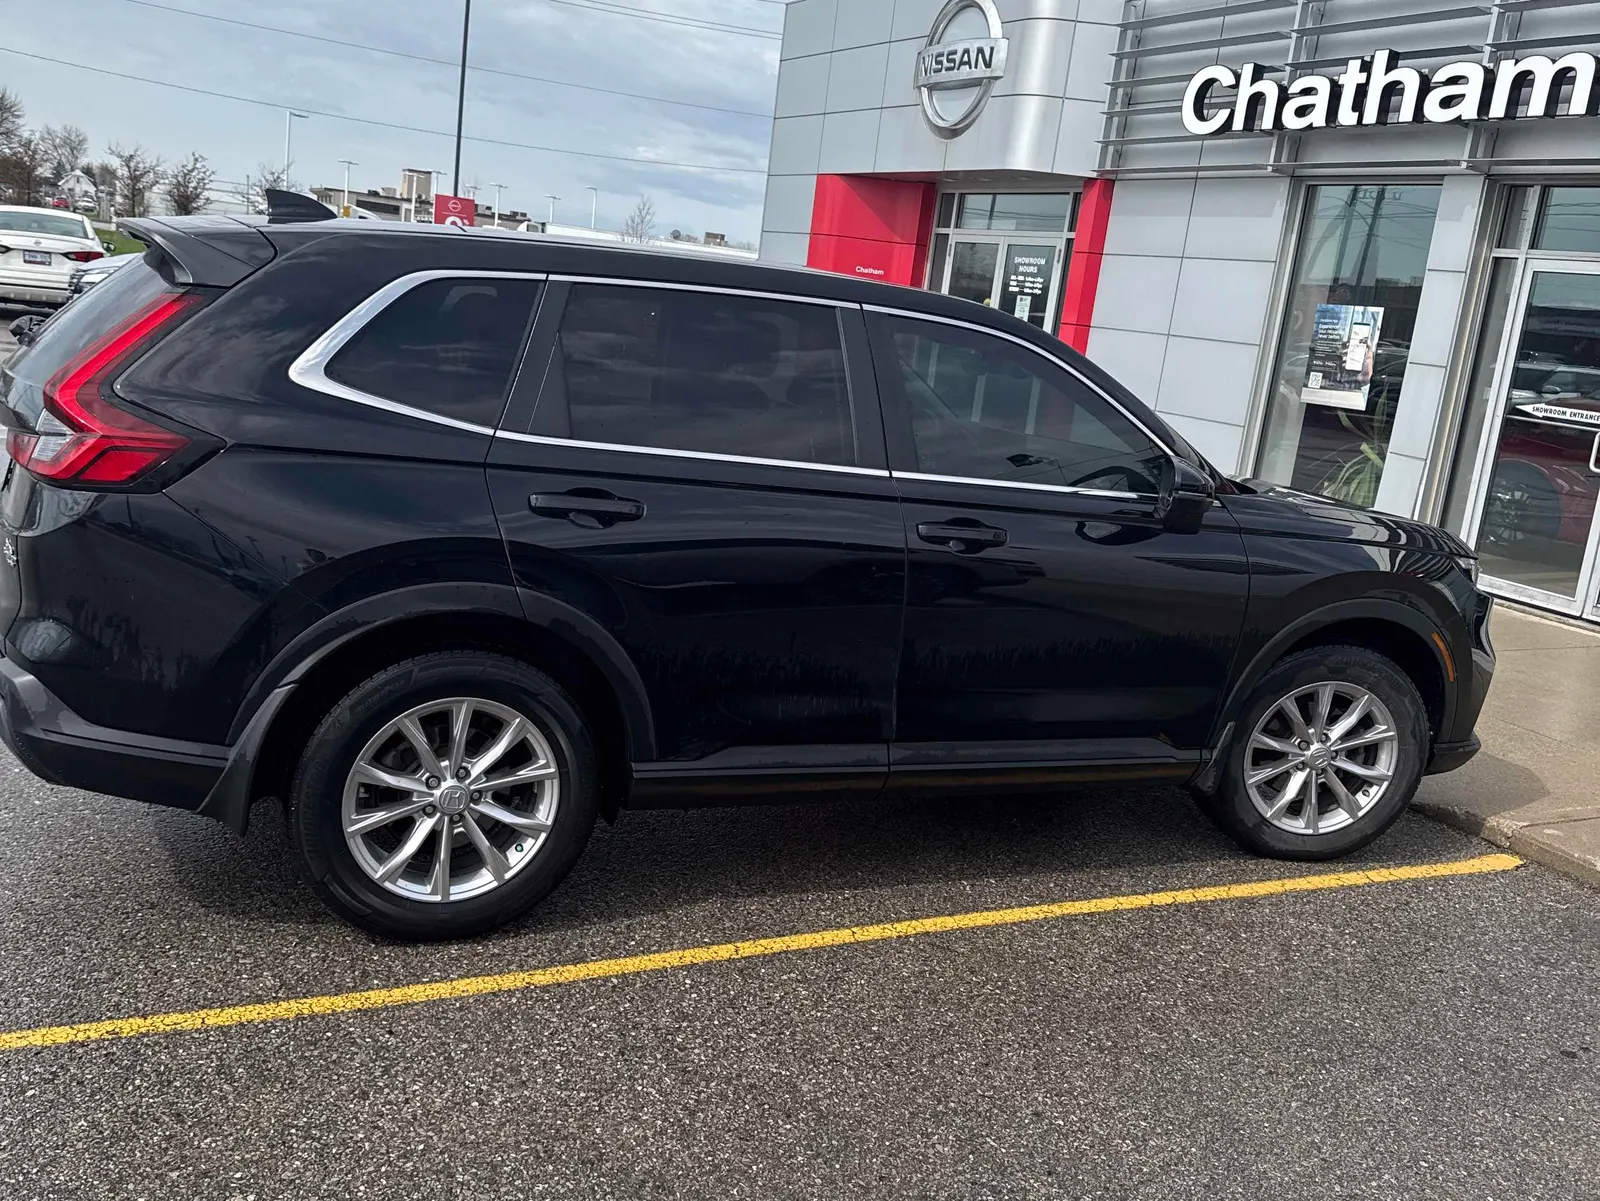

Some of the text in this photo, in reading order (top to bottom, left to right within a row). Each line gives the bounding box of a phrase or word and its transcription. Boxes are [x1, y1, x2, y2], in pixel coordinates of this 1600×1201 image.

[922, 46, 995, 76] NISSAN
[1181, 48, 1600, 135] Chatham
[1013, 256, 1046, 265] SHOWROOM
[855, 265, 885, 276] Chatham
[1018, 265, 1038, 273] HOURS
[1532, 406, 1600, 421] SHOWROOM ENTRANCE
